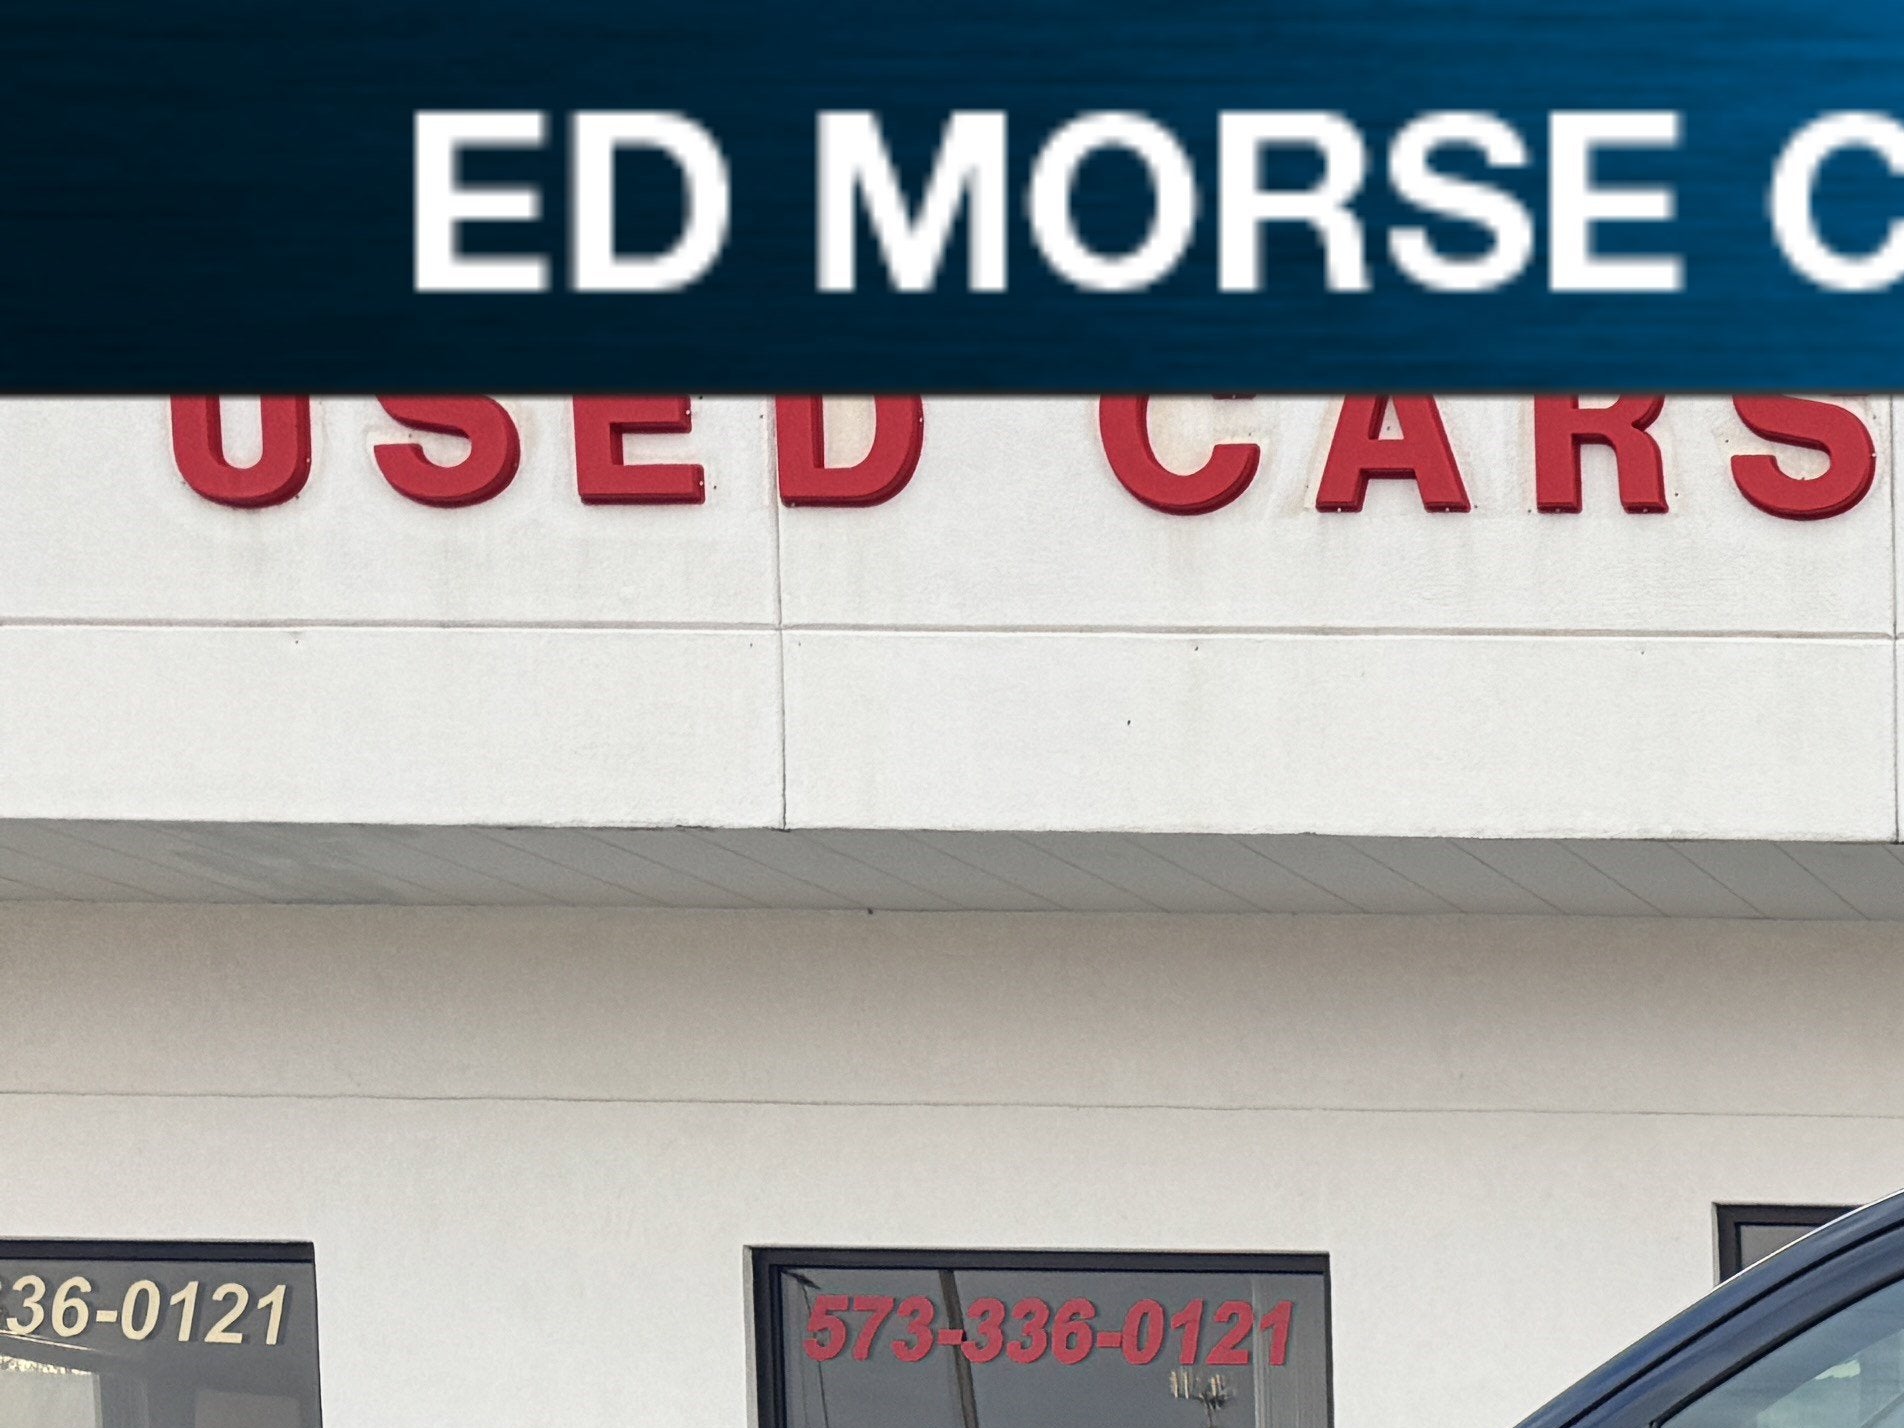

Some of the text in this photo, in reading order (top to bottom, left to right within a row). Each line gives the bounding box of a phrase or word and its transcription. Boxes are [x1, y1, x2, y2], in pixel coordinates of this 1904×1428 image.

[171, 394, 925, 509] USED
[1099, 394, 1877, 521] CARS
[0, 1274, 287, 1346] 36-0121
[803, 1293, 1293, 1367] 573-336-0121
